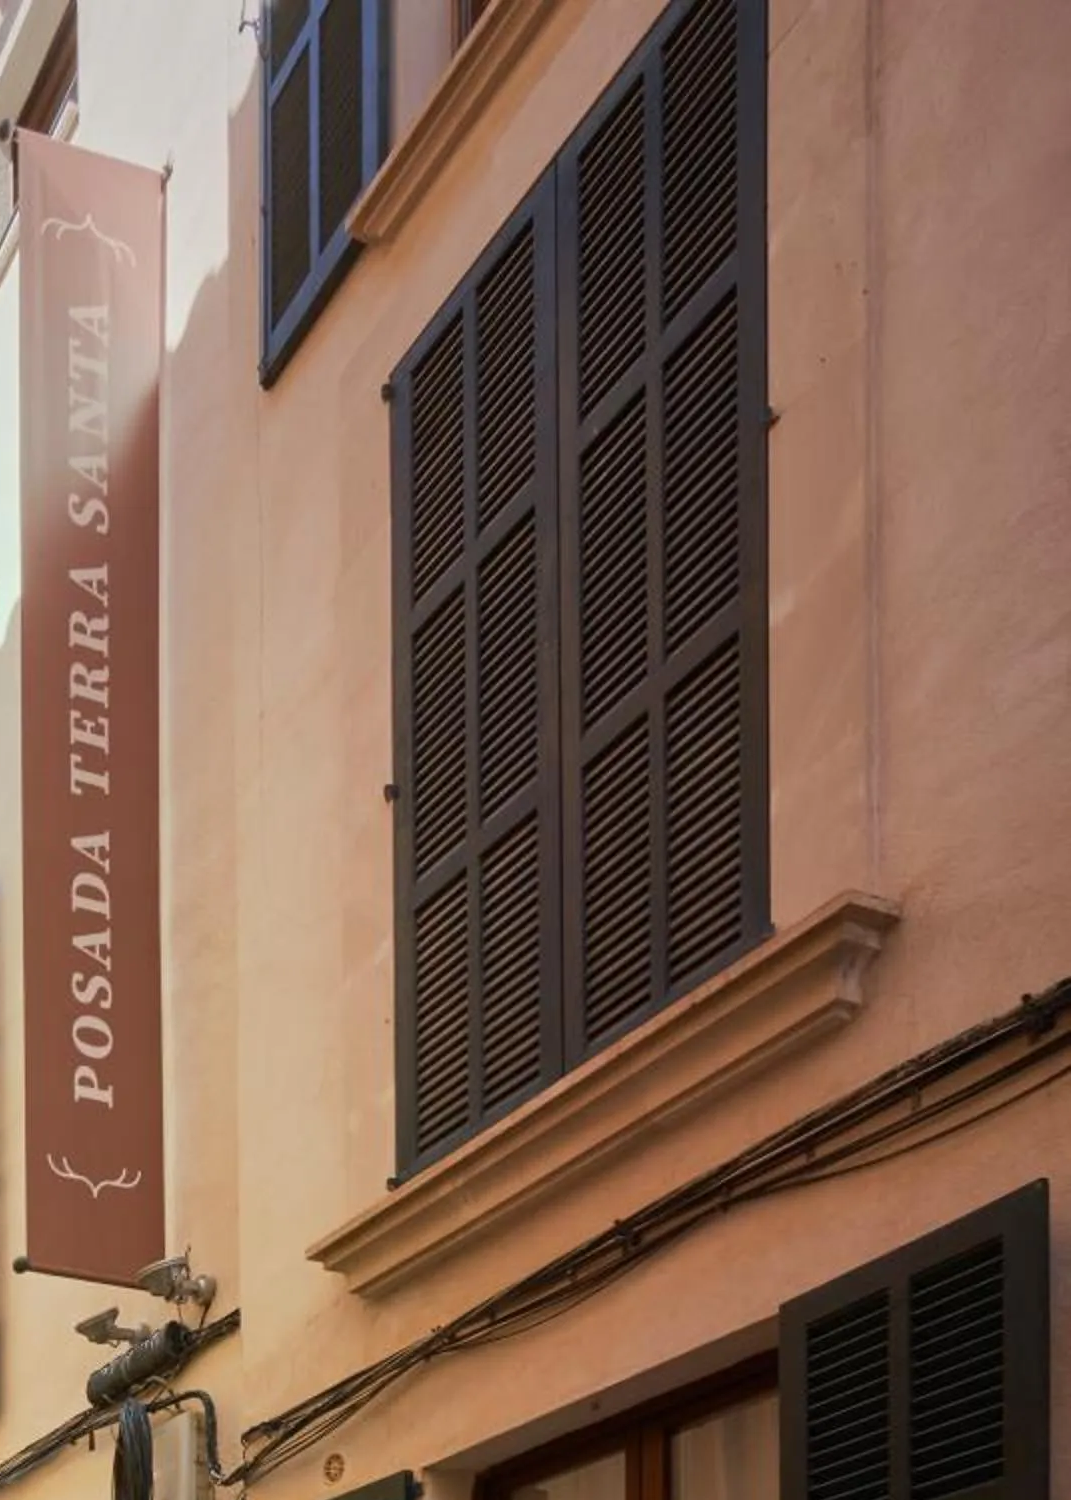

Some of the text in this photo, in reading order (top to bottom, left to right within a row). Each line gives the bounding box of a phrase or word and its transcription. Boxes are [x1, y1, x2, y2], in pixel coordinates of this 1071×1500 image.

[67, 303, 113, 1109] POSADA TERRA SANTA
